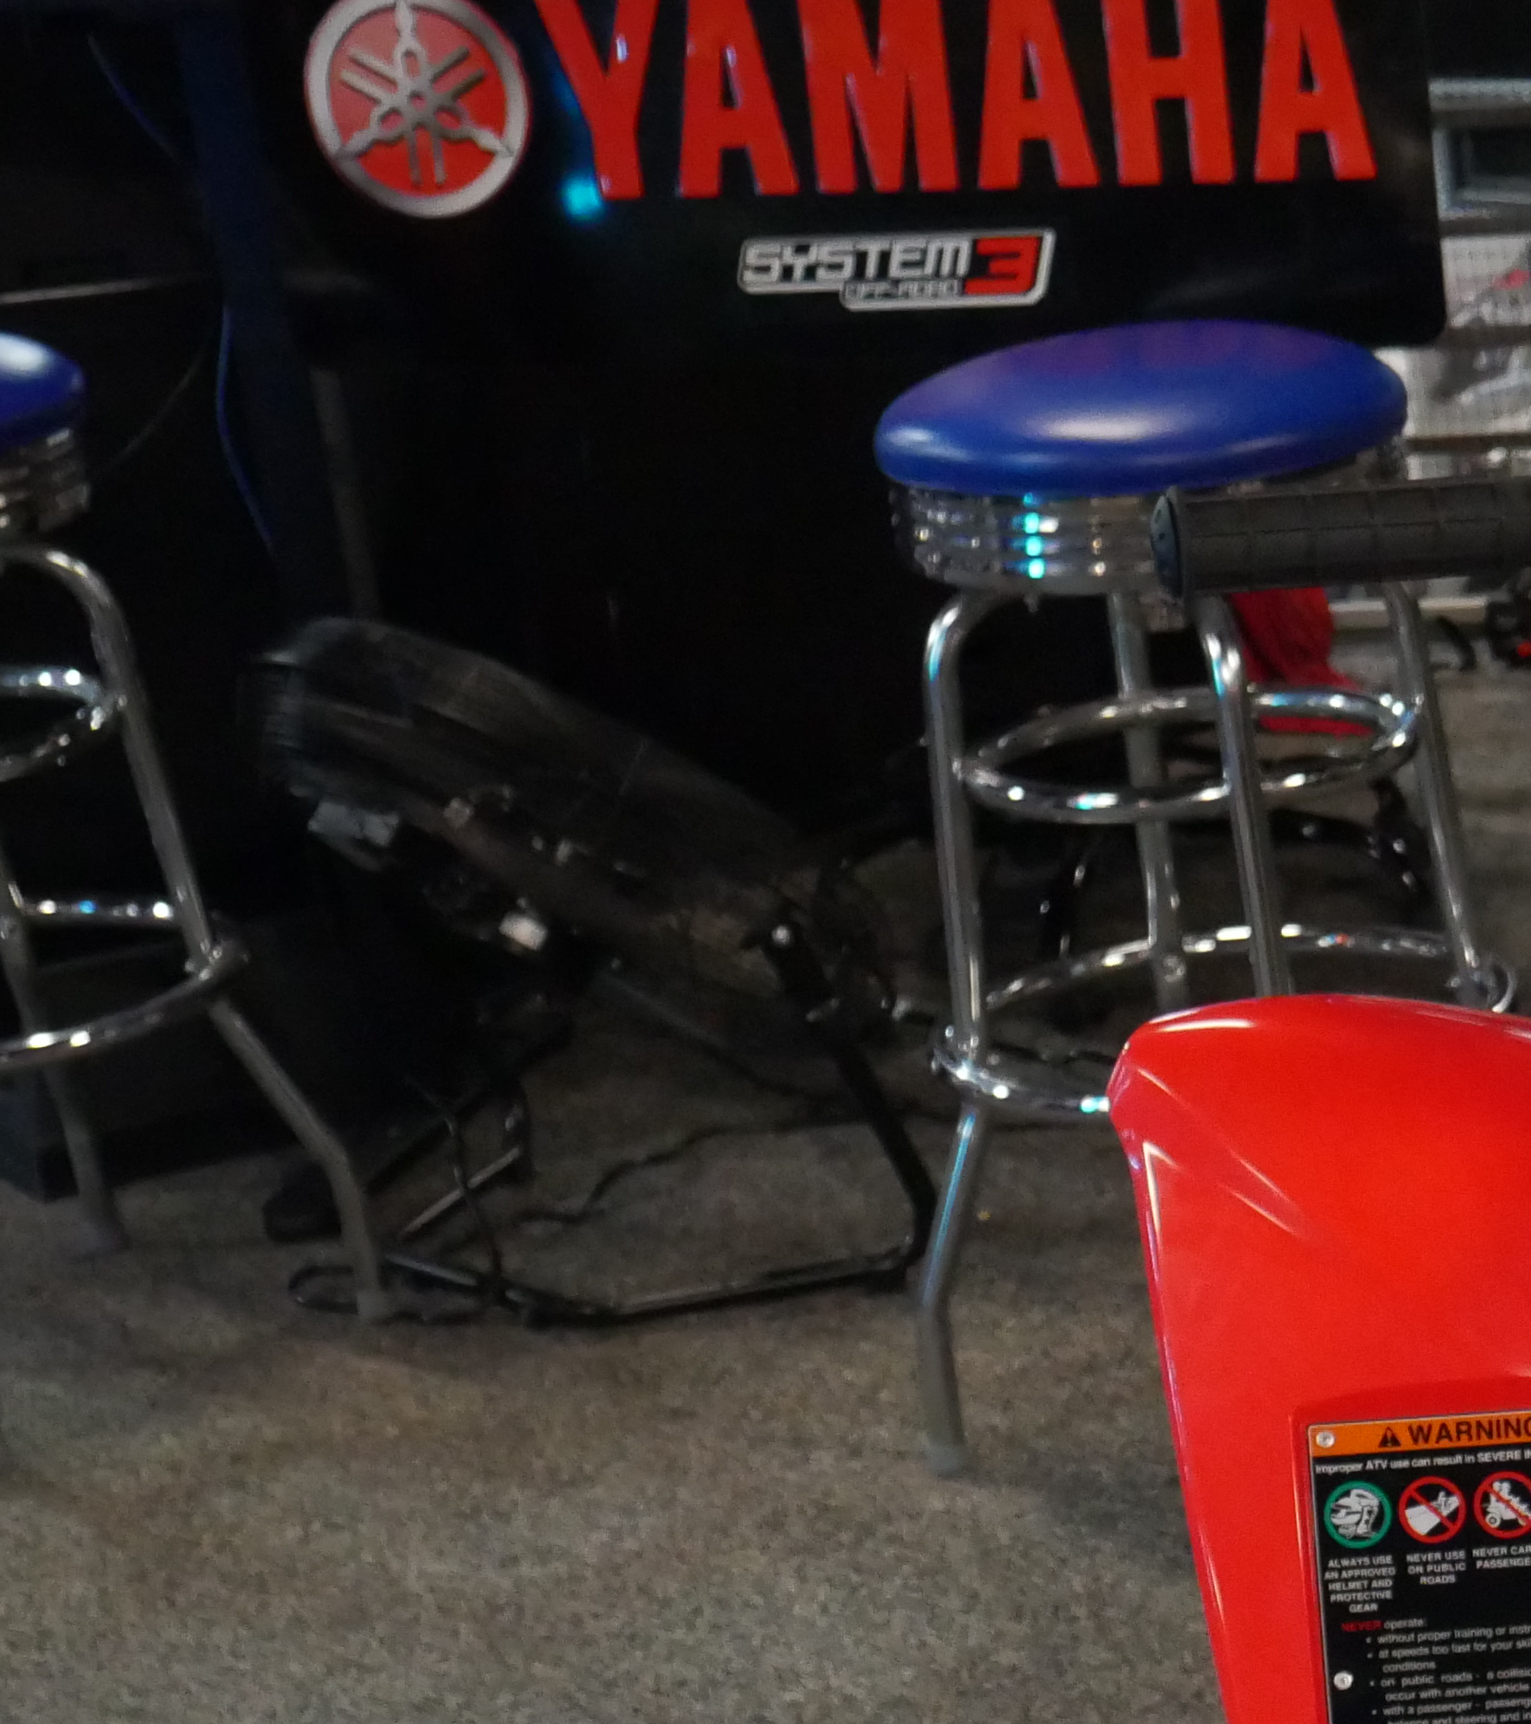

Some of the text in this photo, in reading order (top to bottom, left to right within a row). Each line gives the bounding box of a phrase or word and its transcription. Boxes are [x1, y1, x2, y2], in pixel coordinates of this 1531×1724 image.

[533, 0, 1376, 198] YAMAHA
[1365, 1459, 1388, 1470] ATV
[1389, 1458, 1410, 1469] use
[1411, 1456, 1431, 1467] can
[1433, 1454, 1463, 1466] result
[1464, 1453, 1475, 1463] in
[1477, 1449, 1521, 1463] SEVERE
[1406, 1550, 1466, 1562] NEVER USE
[1472, 1546, 1508, 1557] NEVER
[1328, 1554, 1393, 1569] ALWAYS USE
[1324, 1566, 1396, 1580] AN APPROVED
[1407, 1562, 1466, 1575] ON PUBLIC
[1328, 1578, 1393, 1591] HELMET AND
[1420, 1574, 1456, 1585] ROADS
[1330, 1590, 1392, 1603] PROTECTIVE
[1349, 1603, 1378, 1613] GEAR
